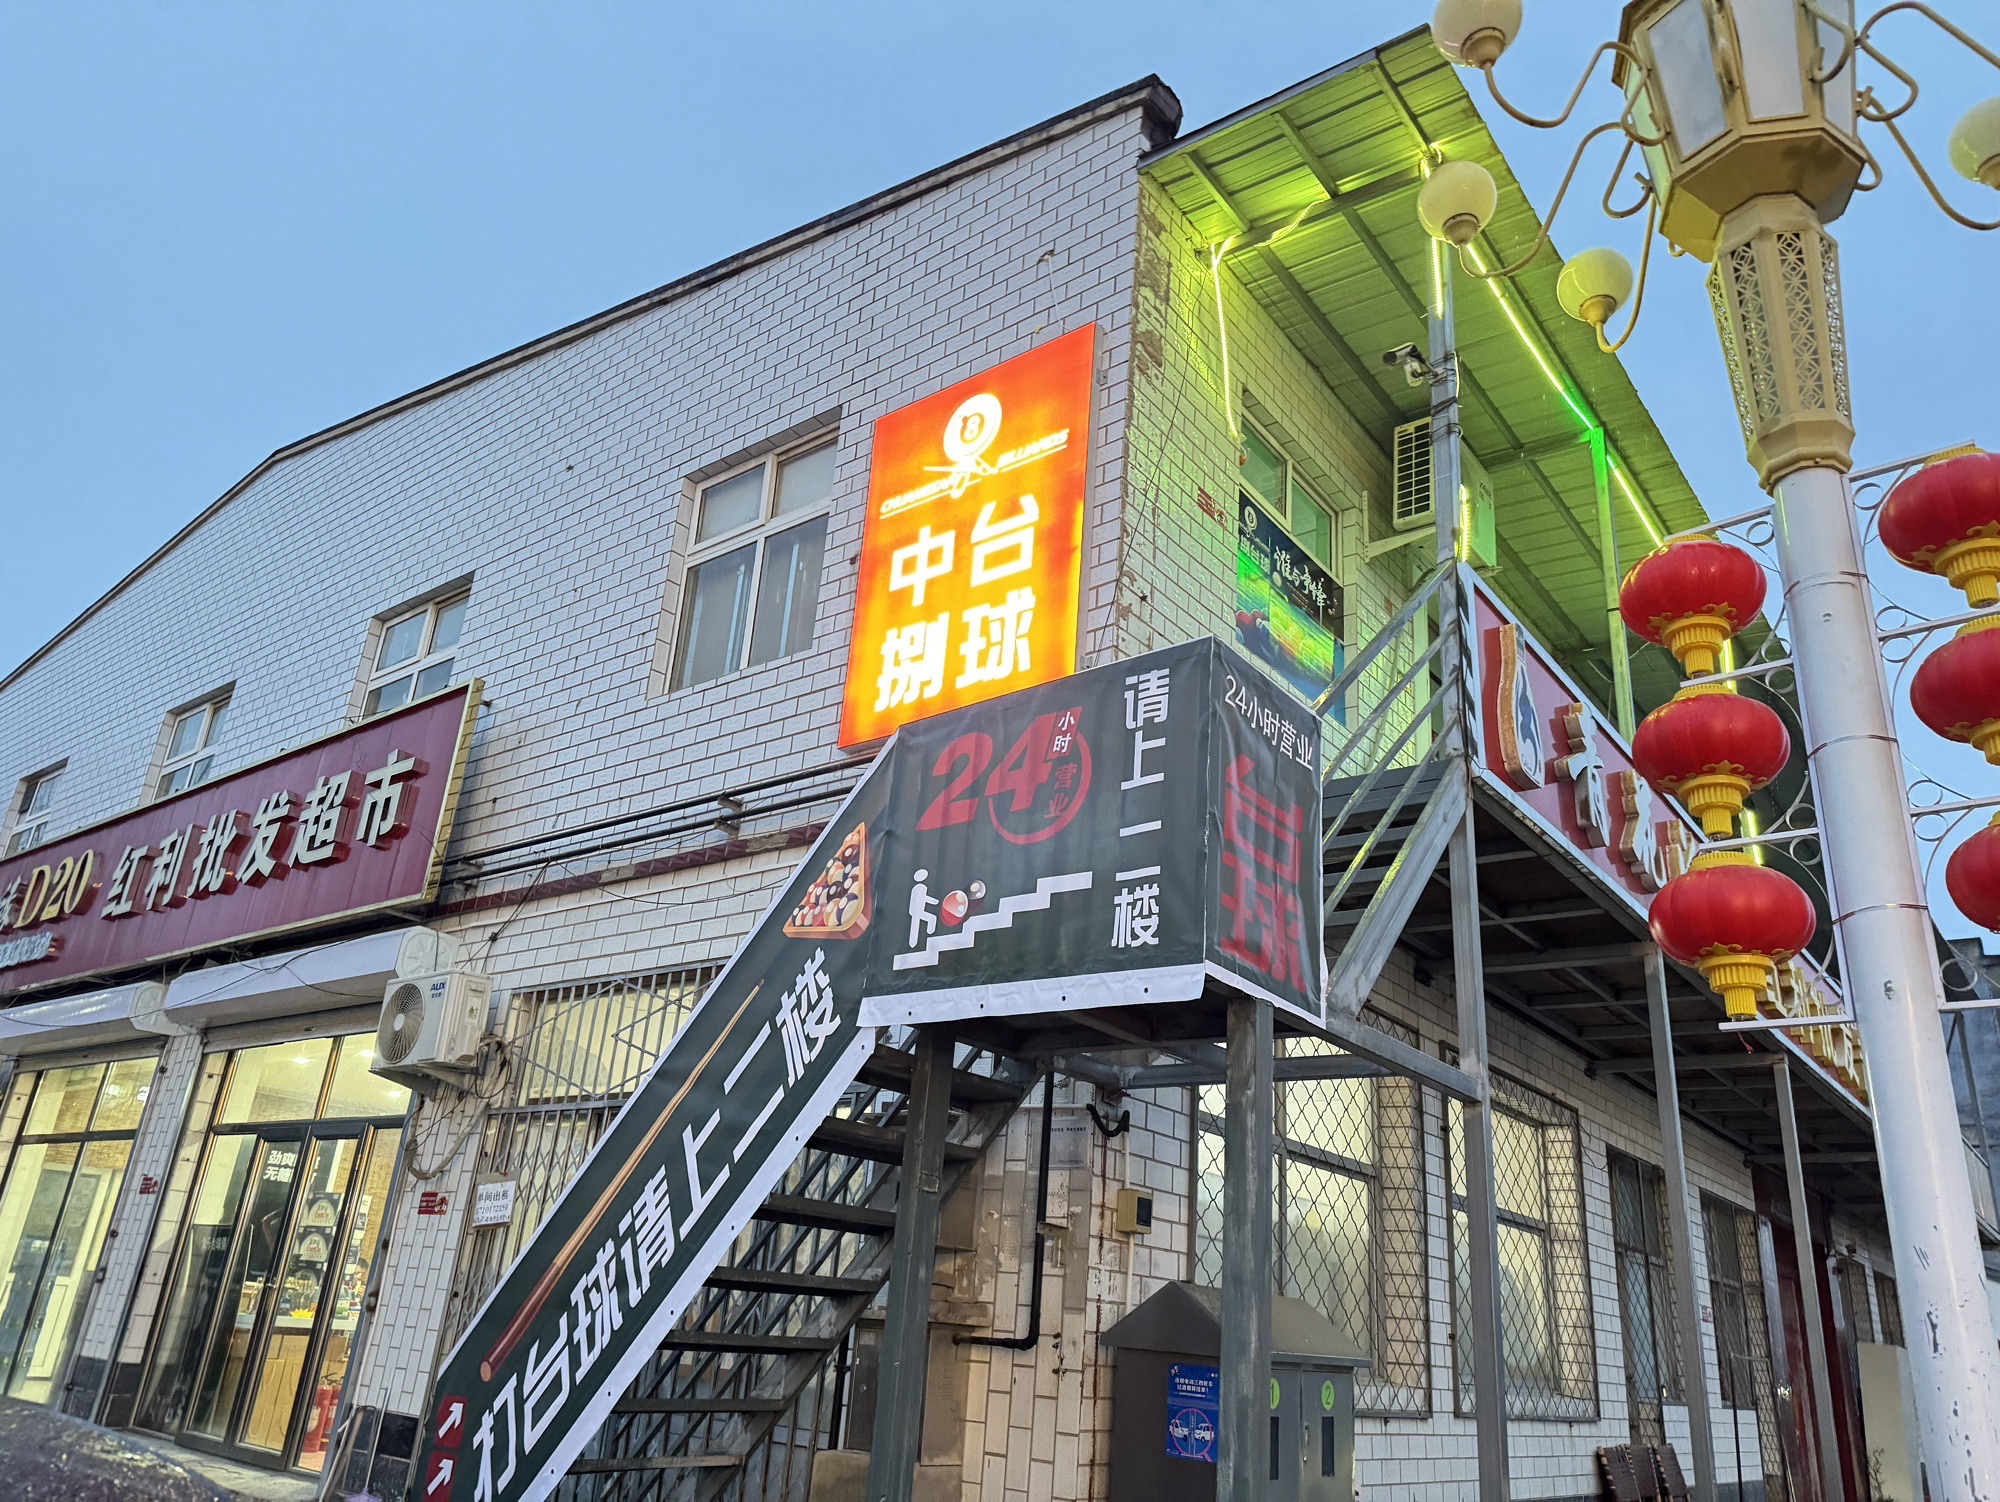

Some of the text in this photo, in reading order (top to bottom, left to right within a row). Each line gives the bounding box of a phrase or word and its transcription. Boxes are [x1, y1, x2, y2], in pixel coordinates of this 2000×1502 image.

[916, 711, 1056, 832] 24
[1052, 711, 1076, 753] 小时
[1224, 674, 1314, 772] 24小时营业
[100, 748, 416, 920] 红利批发超市
[1111, 668, 1170, 949] 请上二楼
[1220, 753, 1306, 994] 台球
[430, 981, 446, 991] AUX
[472, 946, 842, 1502] 打台球请上二楼
[1325, 1385, 1331, 1405] 2
